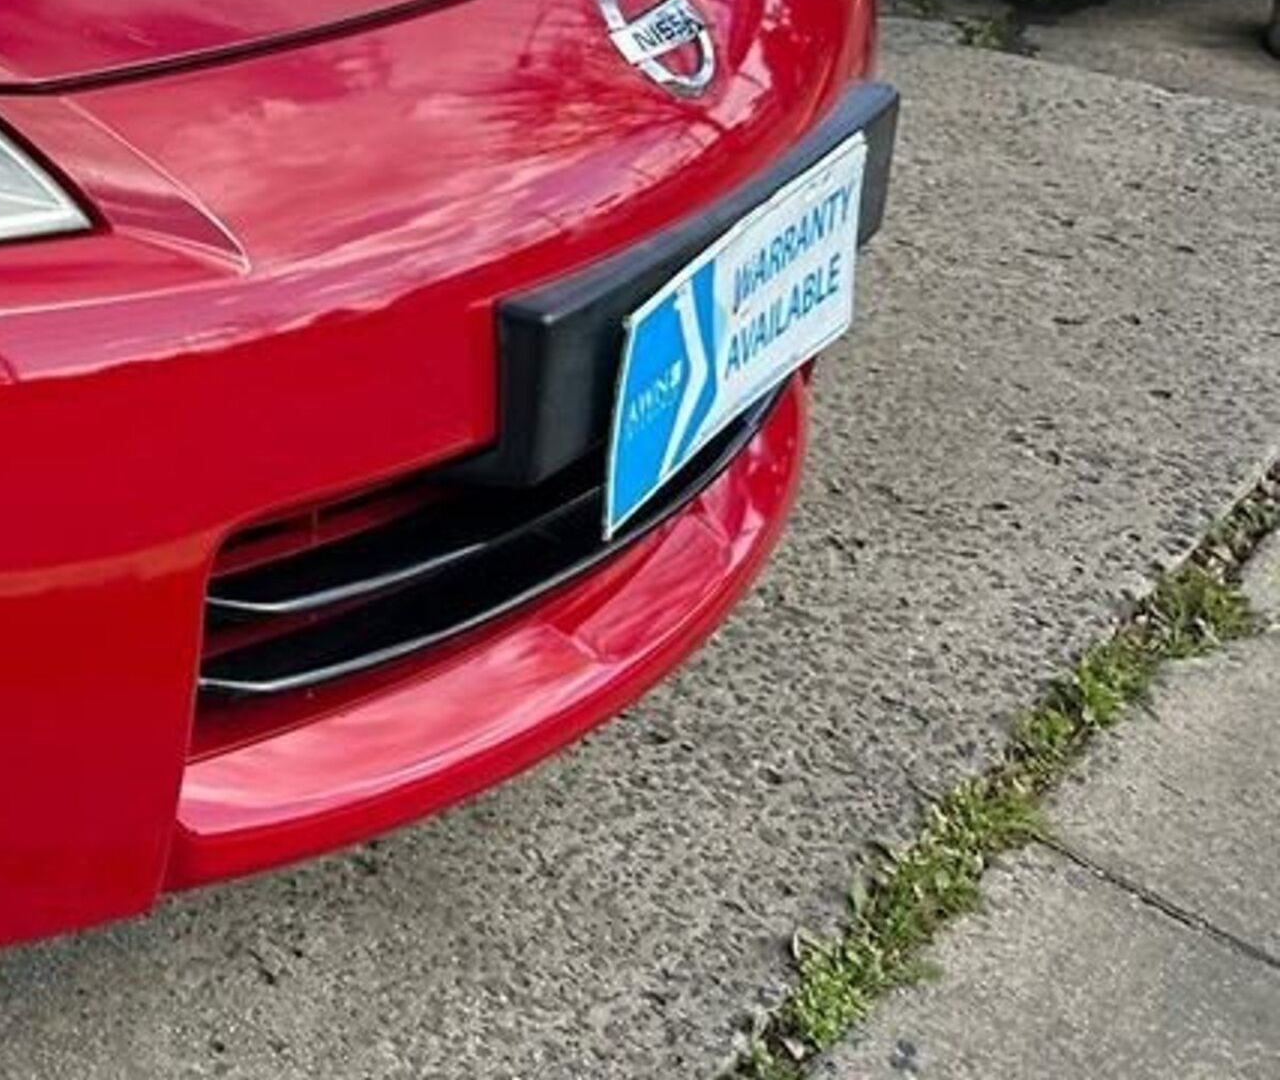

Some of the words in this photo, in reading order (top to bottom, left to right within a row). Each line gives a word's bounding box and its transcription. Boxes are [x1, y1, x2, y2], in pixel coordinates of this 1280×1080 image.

[631, 8, 703, 51] NISS
[733, 185, 855, 308] WARRANTY
[726, 255, 840, 374] AVAILABLE
